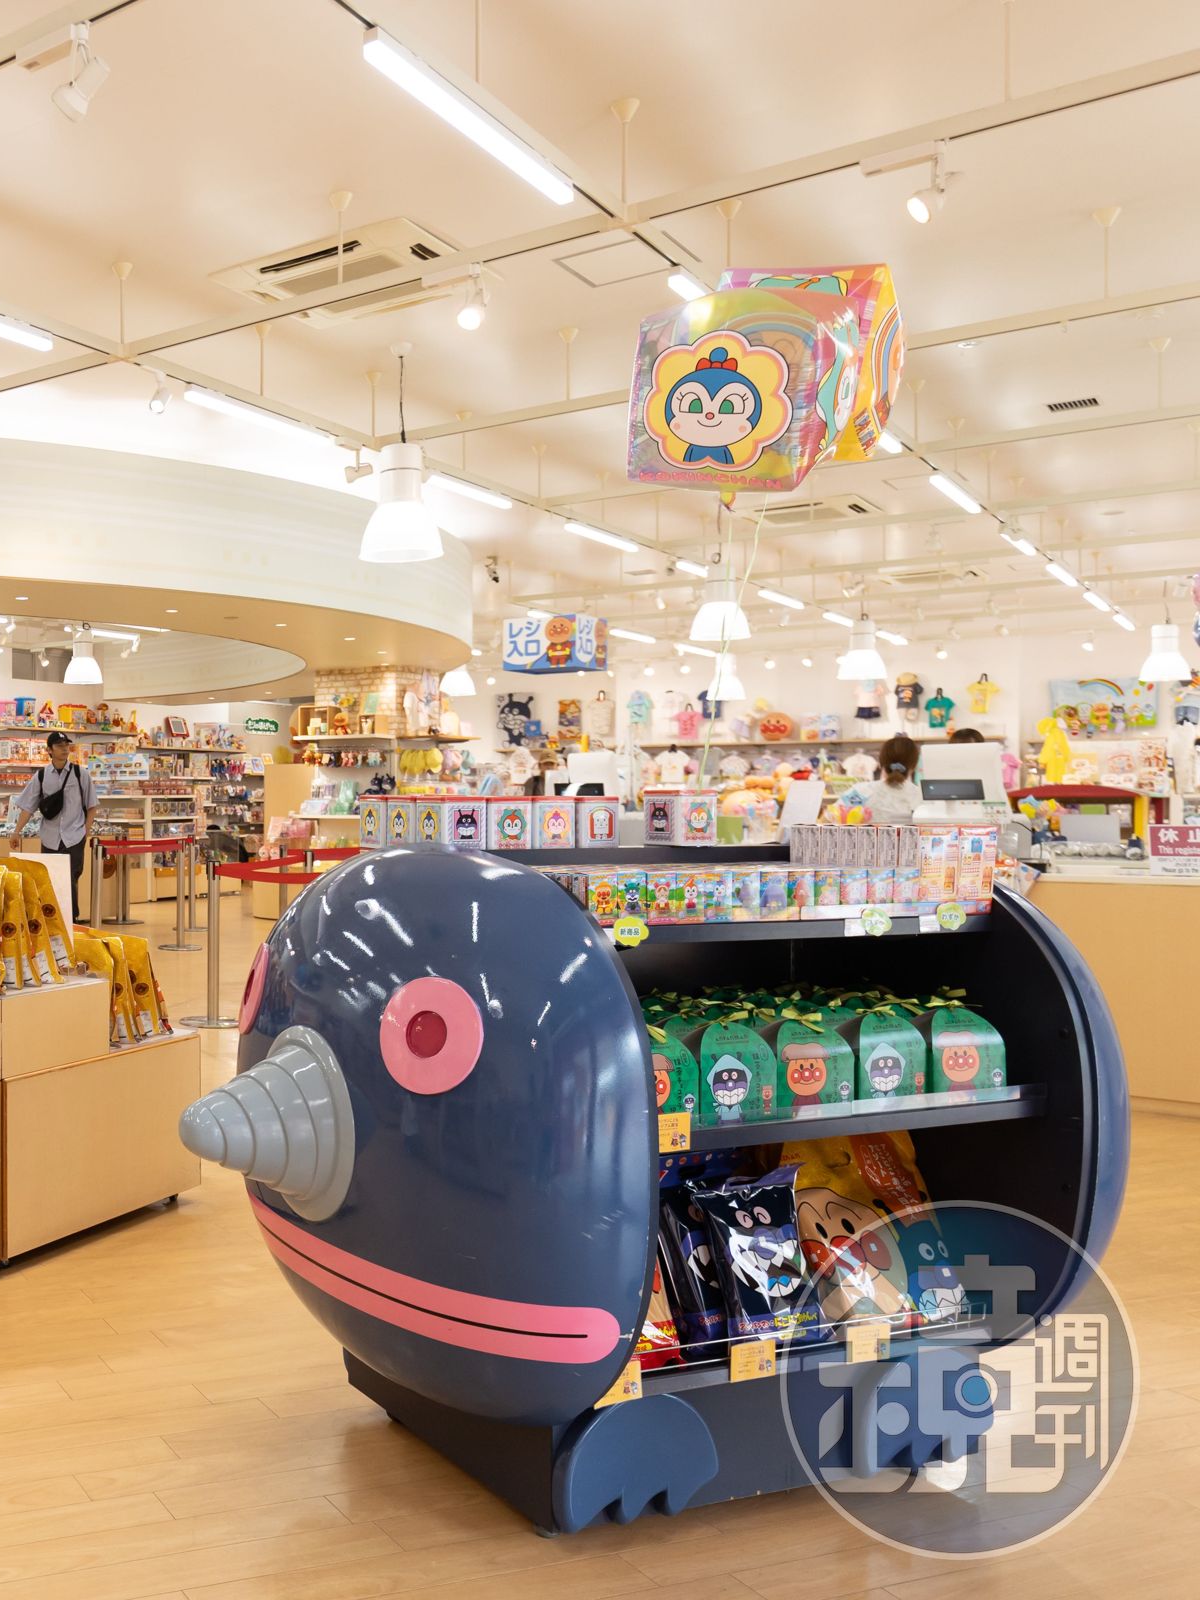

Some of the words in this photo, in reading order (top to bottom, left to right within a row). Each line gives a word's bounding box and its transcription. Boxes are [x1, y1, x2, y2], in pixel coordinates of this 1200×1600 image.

[508, 620, 541, 639] レジ
[577, 618, 593, 636] レジ
[506, 639, 541, 658] 入口
[577, 636, 594, 656] 入口
[620, 928, 640, 936] 新商品
